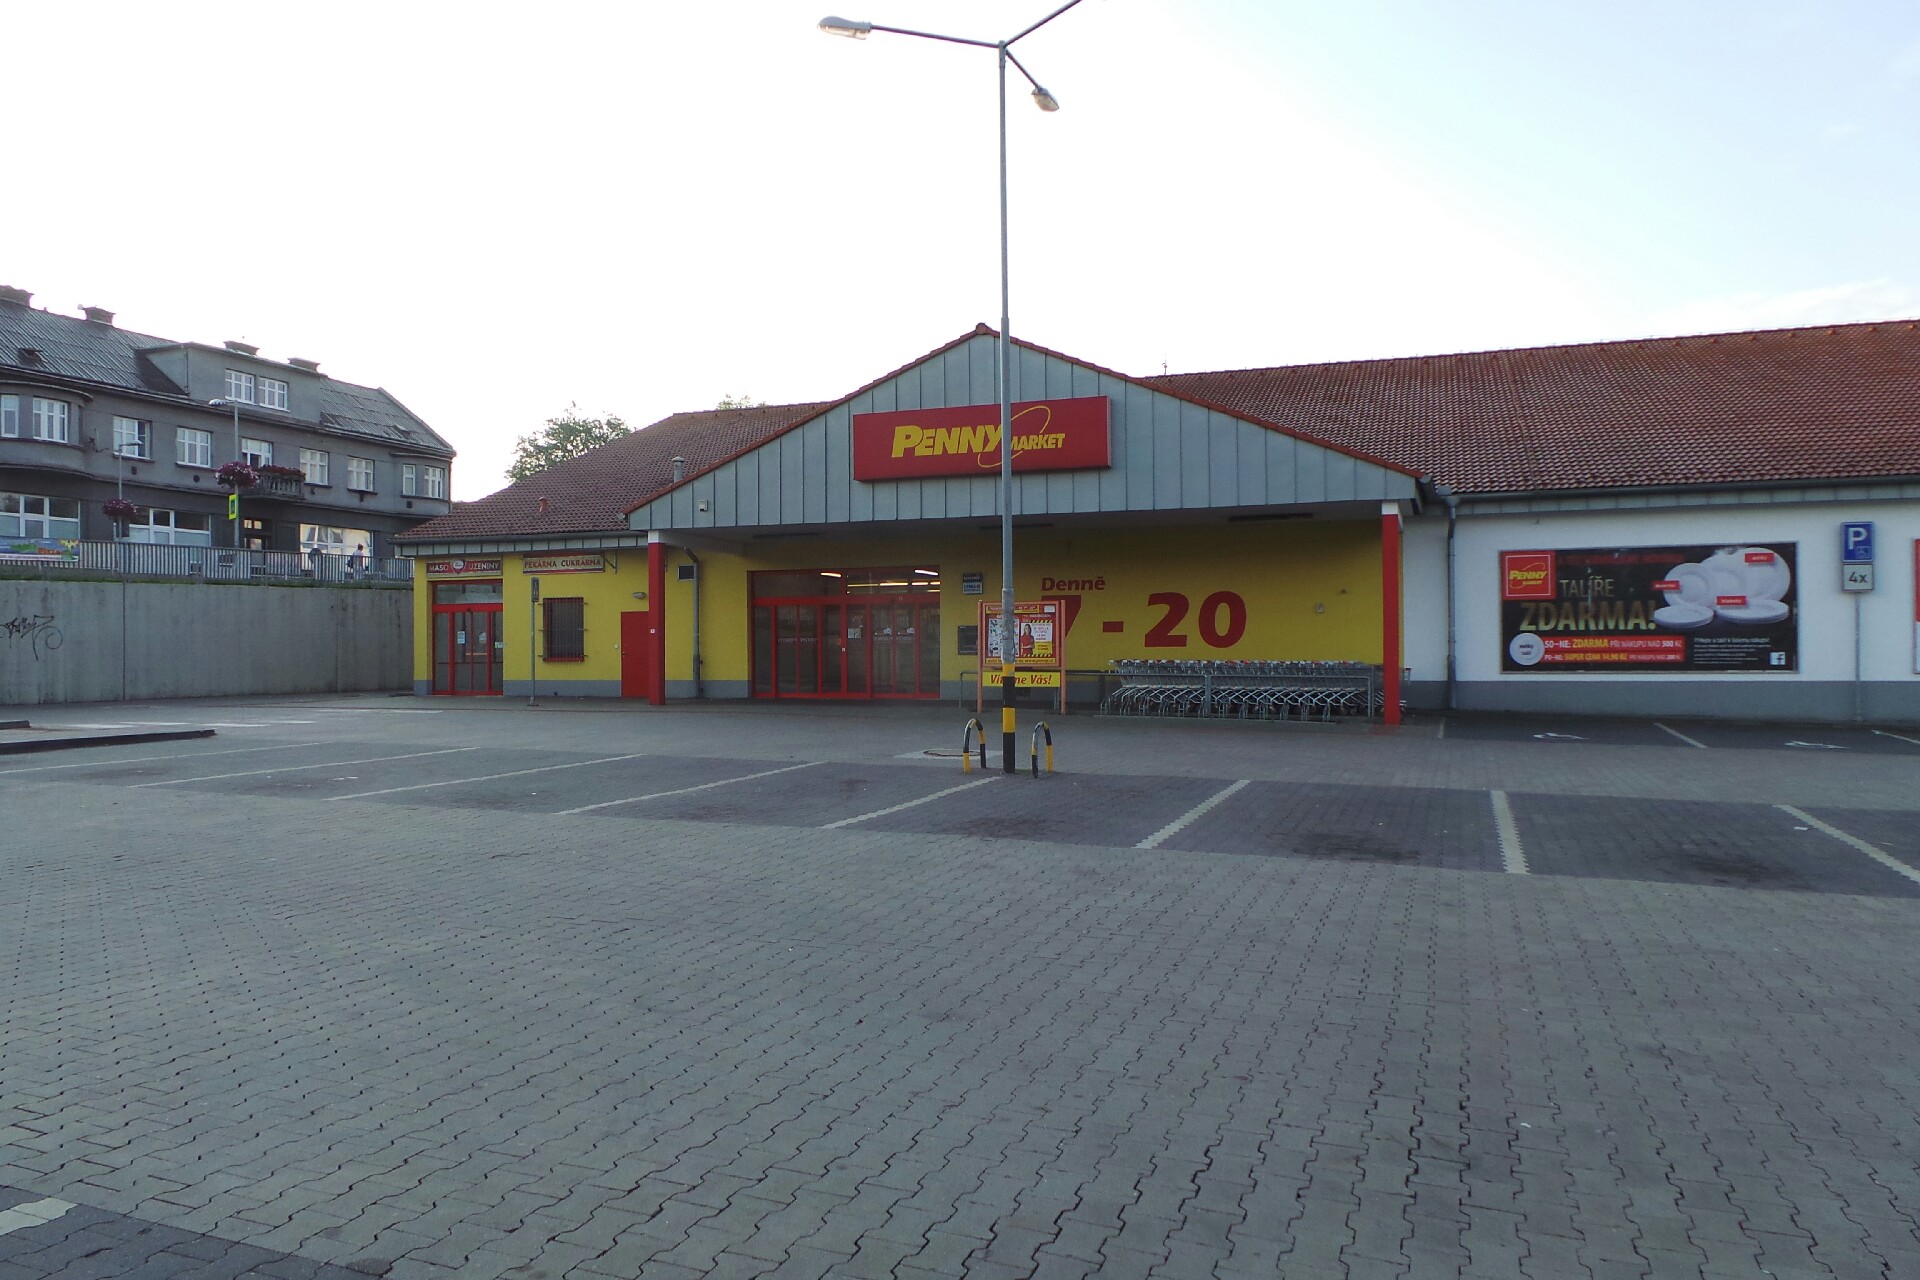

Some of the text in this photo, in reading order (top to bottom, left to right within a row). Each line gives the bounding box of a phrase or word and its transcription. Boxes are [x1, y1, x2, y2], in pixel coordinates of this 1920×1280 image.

[892, 424, 1002, 458] PENNY
[1848, 527, 1867, 550] P
[429, 563, 449, 572] MASO
[469, 561, 500, 571] UZENINY
[1509, 570, 1548, 580] PENNY
[1849, 570, 1868, 584] 4x
[1559, 575, 1615, 598] TALÍŘE
[1144, 590, 1248, 649] 20
[1519, 600, 1657, 631] ZDARMA!
[1572, 638, 1609, 648] ZDARMA
[1030, 674, 1052, 685] Vás!
